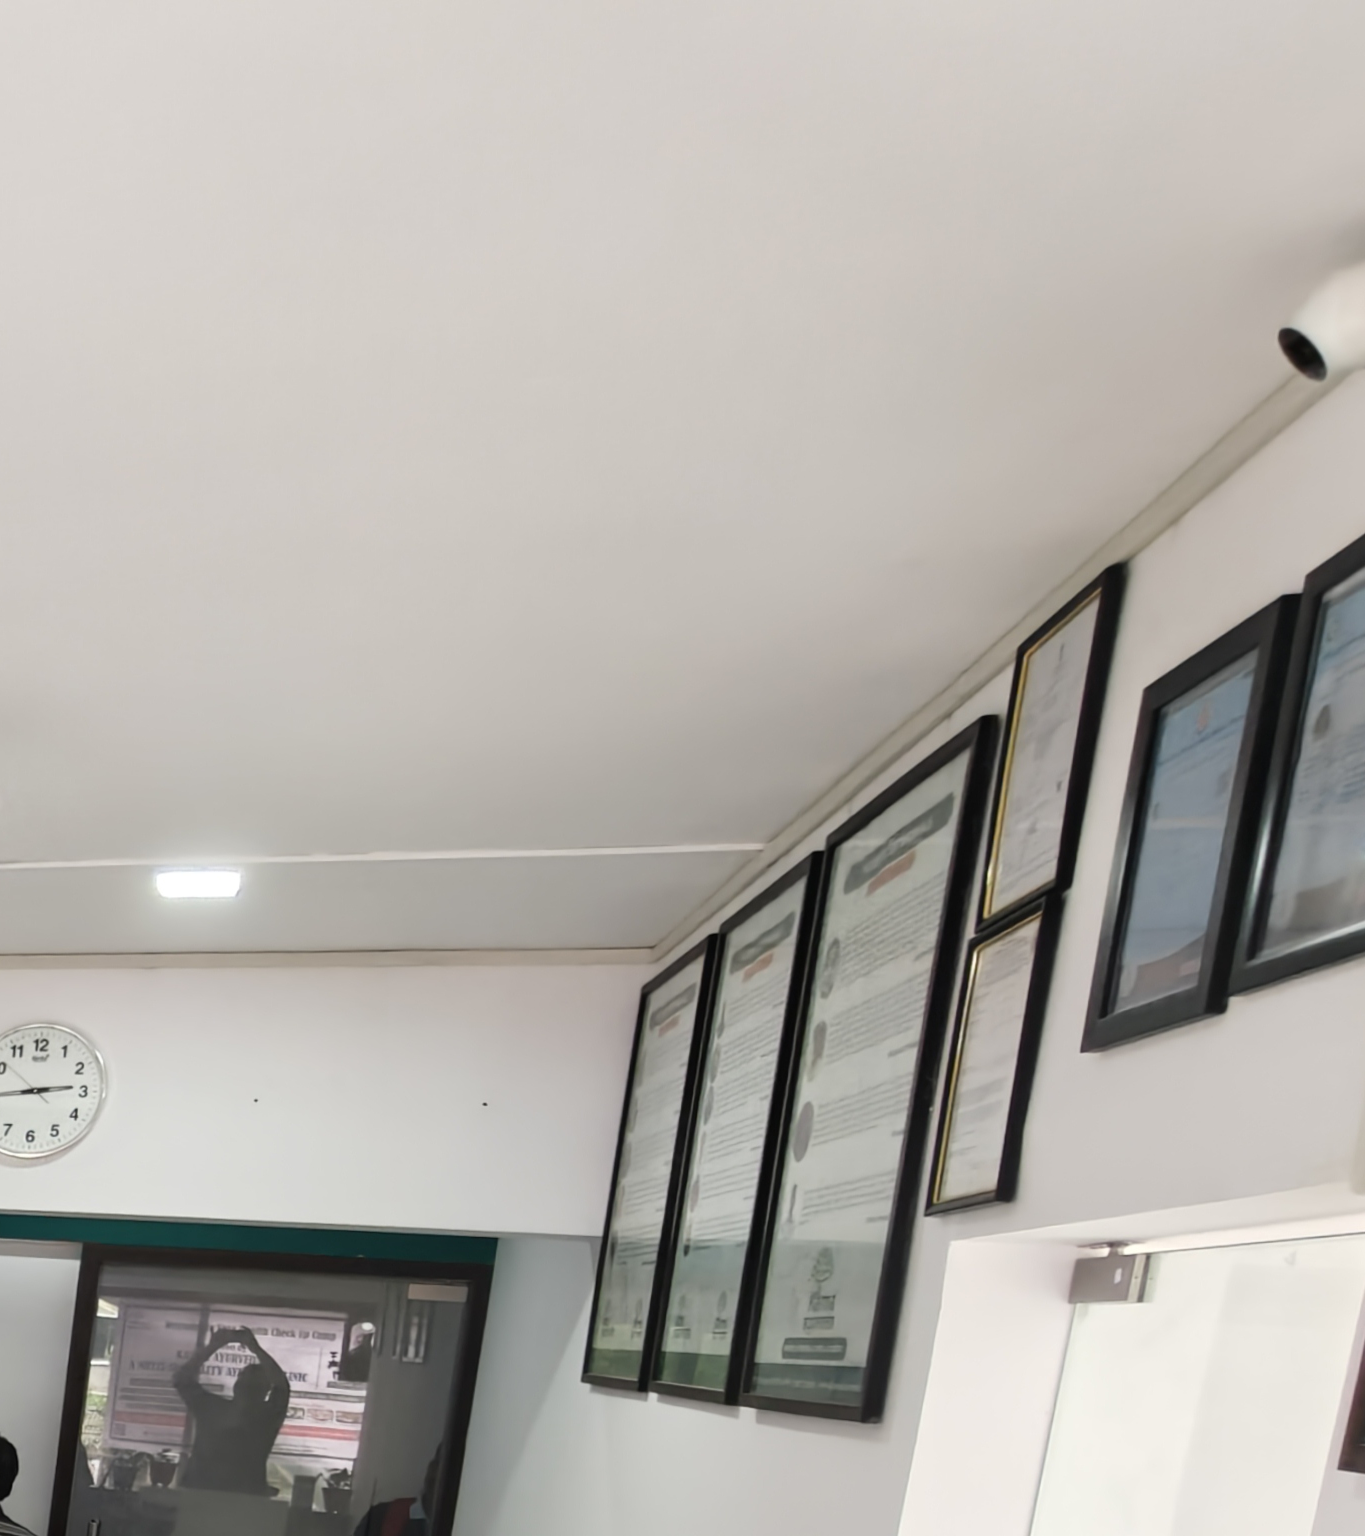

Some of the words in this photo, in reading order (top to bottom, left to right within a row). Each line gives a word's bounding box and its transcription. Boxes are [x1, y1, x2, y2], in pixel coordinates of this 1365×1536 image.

[10, 1044, 24, 1058] 11
[33, 1038, 49, 1052] 12
[61, 1045, 68, 1058] 1
[74, 1062, 85, 1075] 2
[78, 1085, 88, 1098] 3
[69, 1108, 79, 1121] 4
[3, 1124, 13, 1137] 7
[25, 1130, 35, 1143] 6
[50, 1124, 60, 1137] 5
